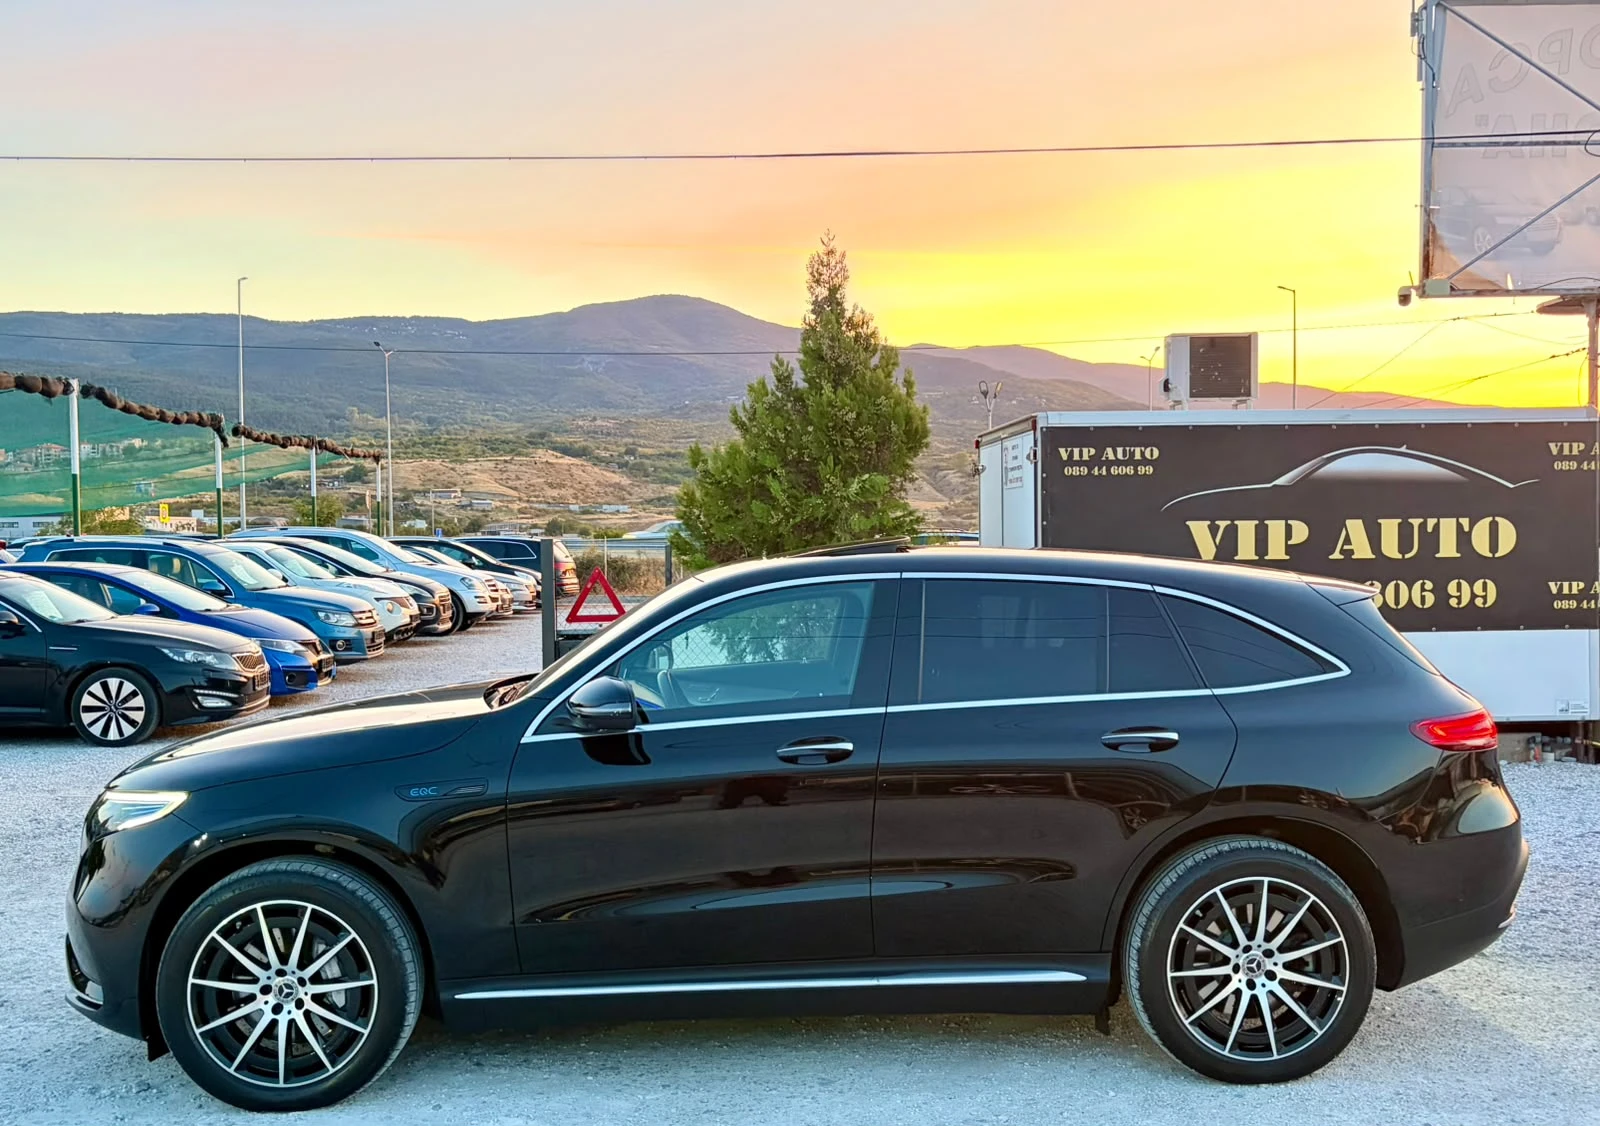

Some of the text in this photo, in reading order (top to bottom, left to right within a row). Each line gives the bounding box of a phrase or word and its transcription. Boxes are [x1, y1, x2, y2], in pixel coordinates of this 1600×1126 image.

[1058, 446, 1160, 461] VIP AUTO
[1548, 442, 1586, 455] VIP
[1063, 465, 1154, 476] 089 44 606 99
[1553, 460, 1596, 471] 089 44
[1184, 516, 1517, 561] VIP AUTO
[1447, 578, 1497, 609] 99
[1547, 581, 1585, 595] VIP
[1552, 599, 1597, 610] 089 44
[410, 786, 438, 797] EQC
